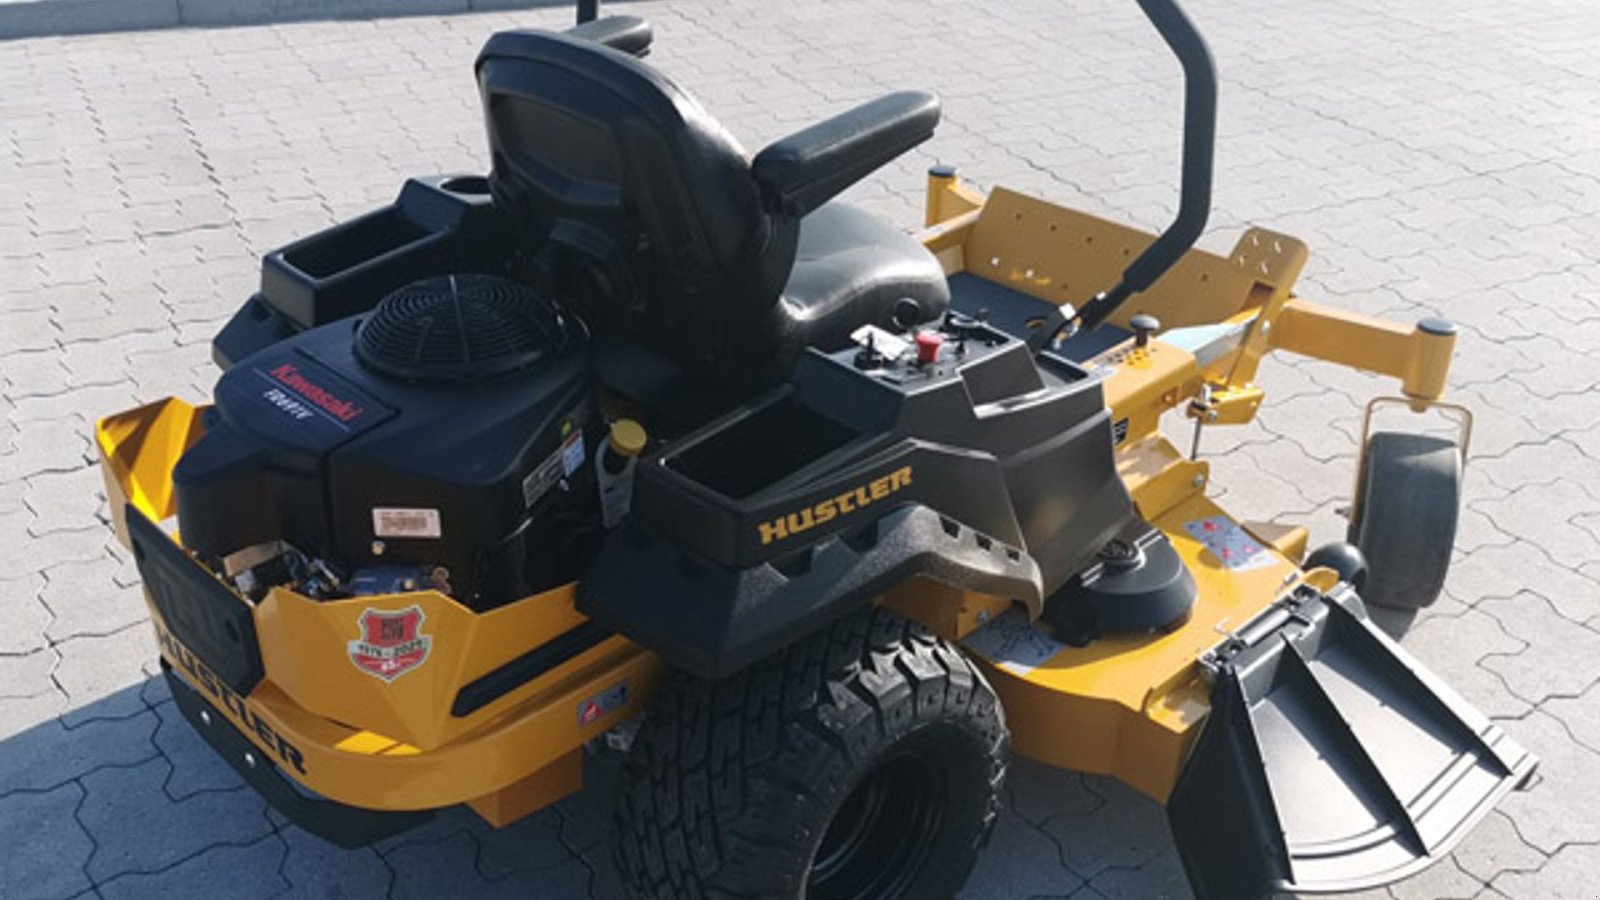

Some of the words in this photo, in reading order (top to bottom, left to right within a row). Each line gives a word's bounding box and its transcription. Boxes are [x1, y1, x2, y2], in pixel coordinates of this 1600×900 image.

[270, 364, 363, 421] Kawasaki
[757, 465, 913, 545] HUSTLER
[157, 630, 307, 775] HUSTLER
